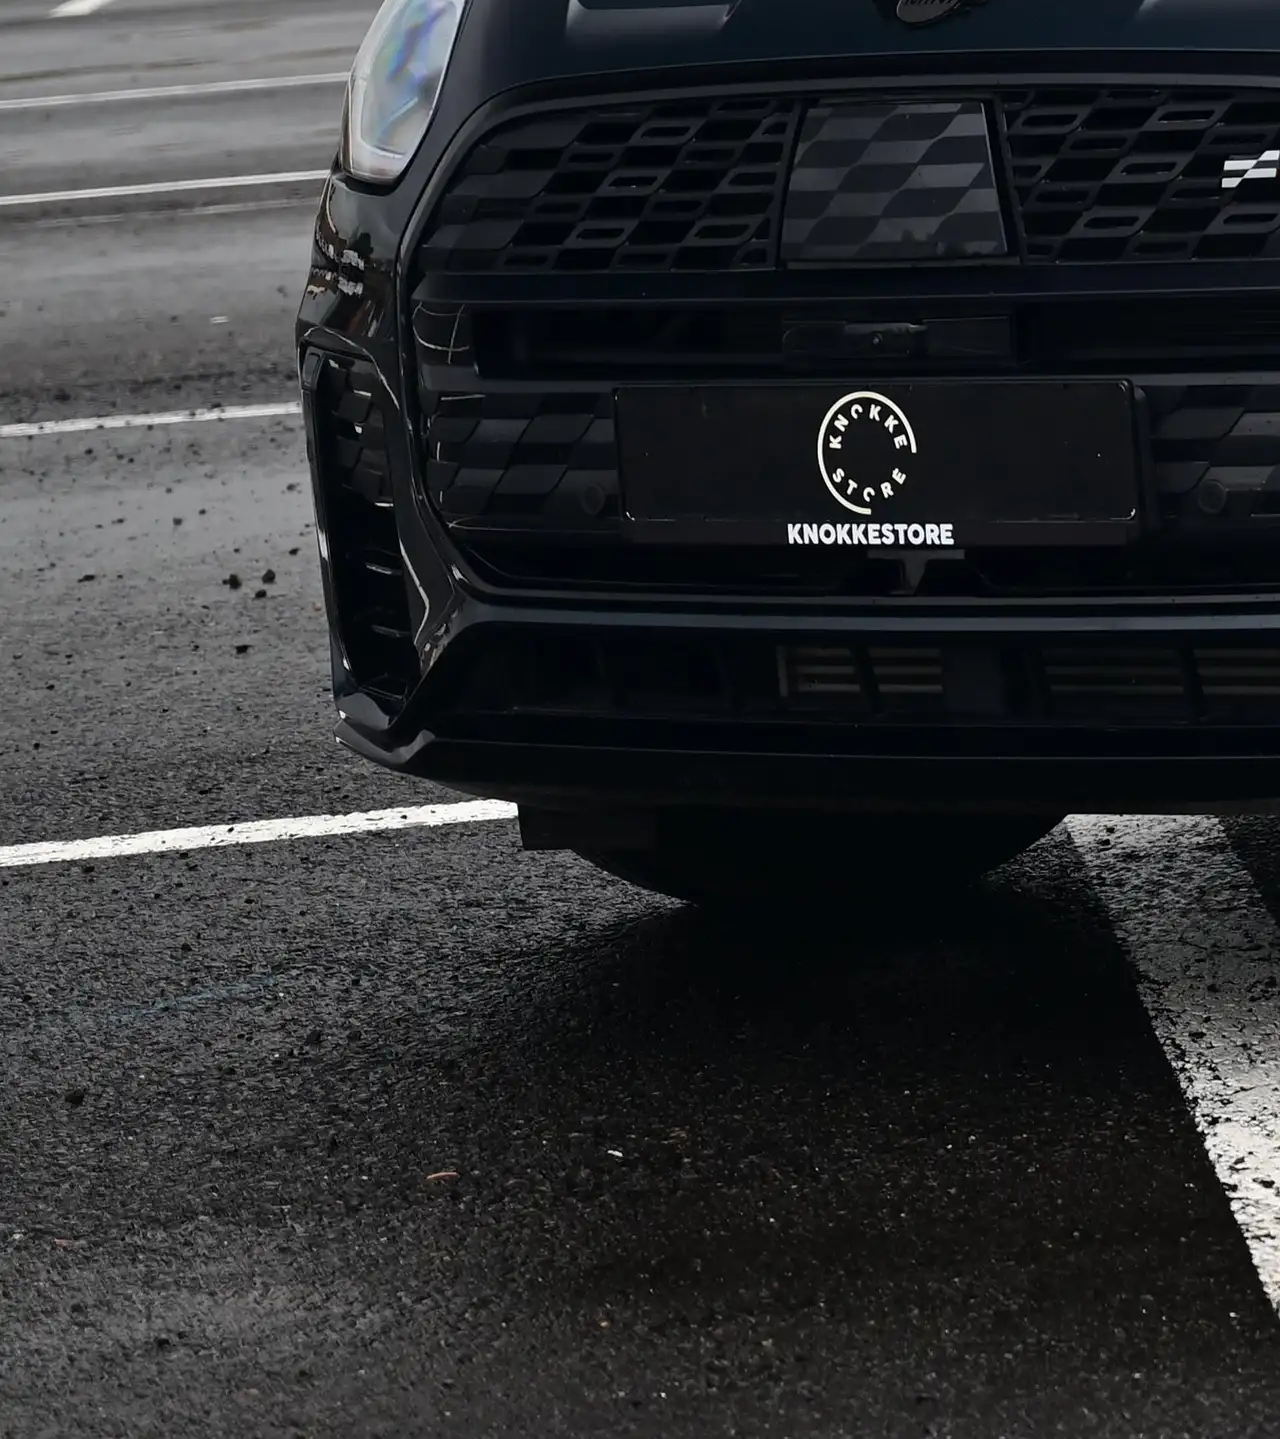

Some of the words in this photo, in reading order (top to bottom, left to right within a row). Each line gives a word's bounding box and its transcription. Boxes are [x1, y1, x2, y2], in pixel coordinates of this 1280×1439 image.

[828, 403, 909, 450] KNOKKE
[832, 467, 908, 503] STORE
[787, 522, 955, 546] KNOKKESTORE
